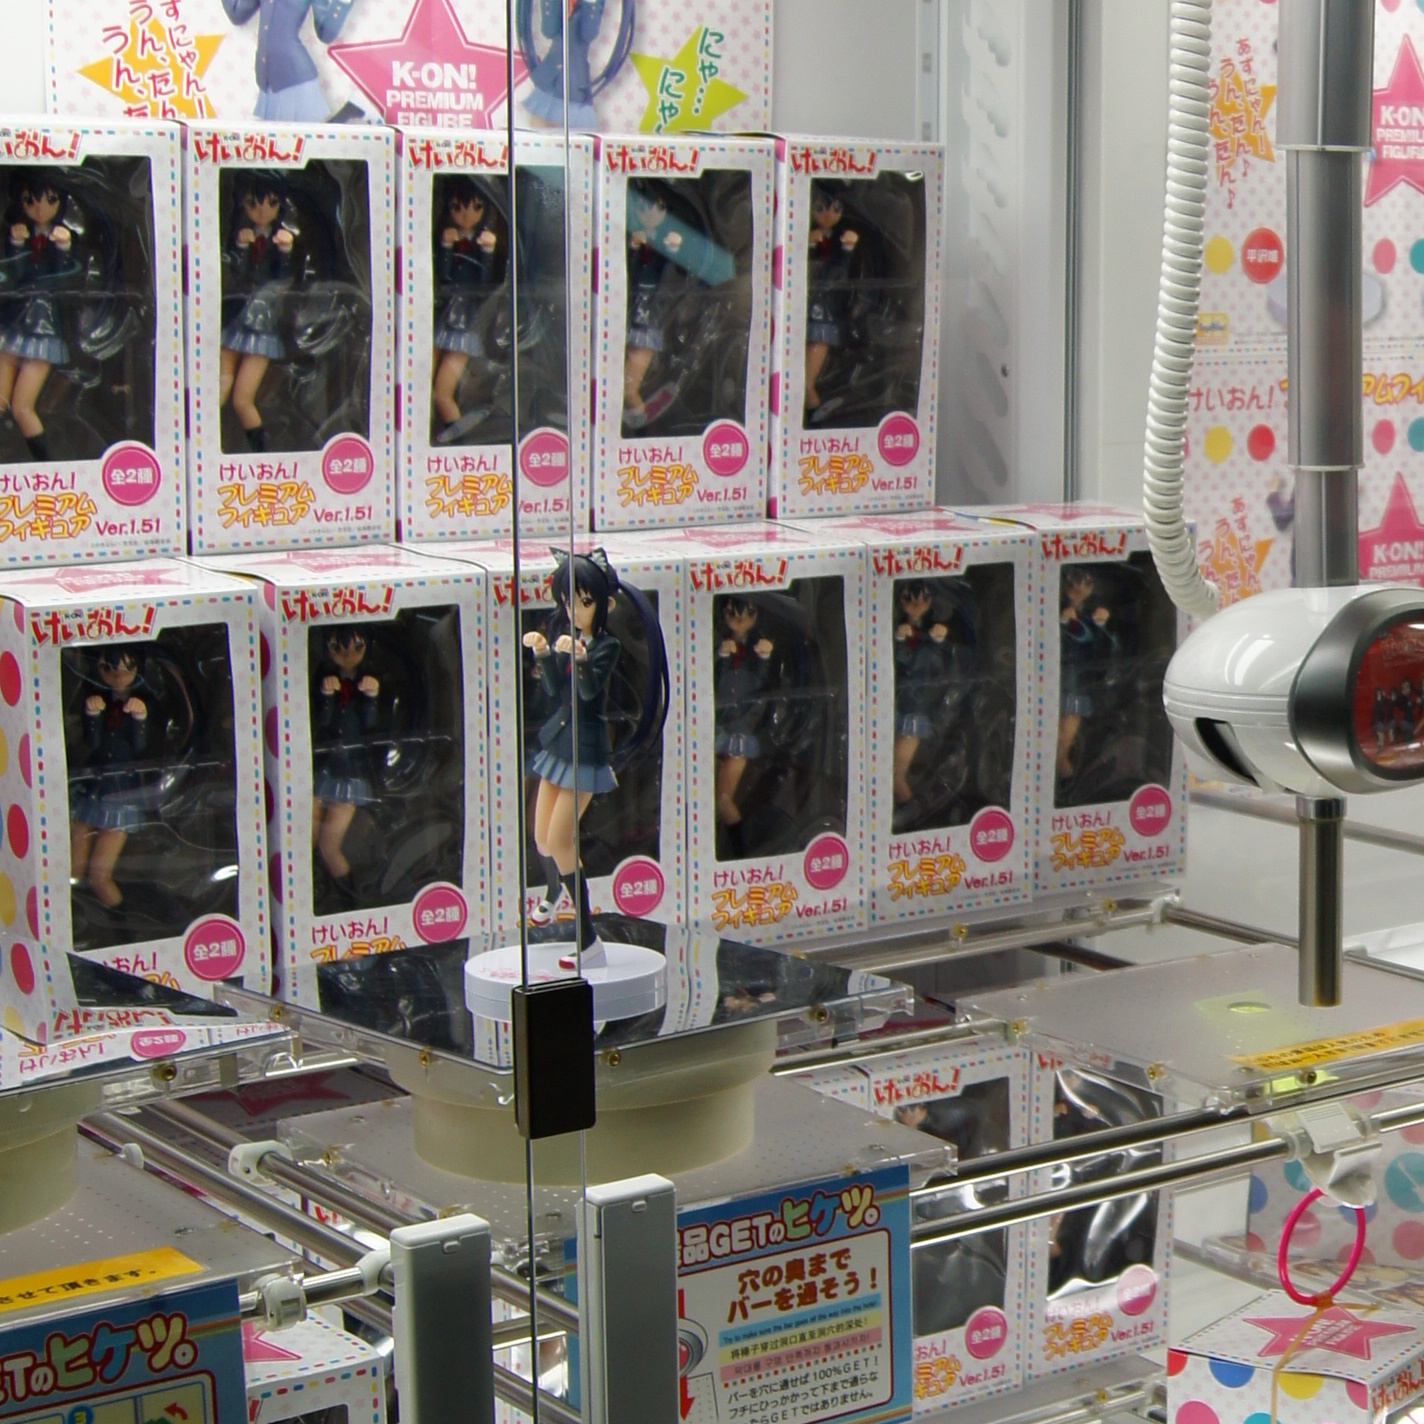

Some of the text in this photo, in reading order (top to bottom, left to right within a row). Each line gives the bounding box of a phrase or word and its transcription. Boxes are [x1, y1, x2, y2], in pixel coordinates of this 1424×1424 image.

[391, 60, 477, 90] K-ON!
[386, 89, 485, 112] PREMIUM
[194, 134, 306, 165] けいおん!
[606, 142, 699, 175] けいおん!
[790, 144, 877, 176] けいおん!
[618, 445, 684, 465] けいおん!
[800, 436, 860, 456] けいおん!
[219, 461, 299, 482] けいおん!
[426, 454, 498, 474] けいおん!
[617, 463, 699, 492] プレミアム
[798, 453, 874, 480] プレミアム
[217, 480, 316, 508] プレミアム
[425, 469, 514, 499] プレミアム
[617, 483, 695, 510] フィギュア
[697, 486, 748, 506] Ver.1.51
[798, 473, 868, 498] フィギュア
[871, 476, 918, 495] Ver.1.51
[217, 502, 312, 530] フィギュア
[313, 504, 373, 524] Ver.1.51
[425, 490, 511, 520] フィギュア
[96, 517, 161, 537] Ver.1.51
[1041, 532, 1128, 561] けいおん!
[1372, 539, 1424, 563] K-ON!
[872, 545, 964, 577] けいおん!
[690, 558, 788, 592] けいおん!
[281, 586, 396, 624] けいおん!
[31, 606, 157, 646] けいおん!
[1051, 811, 1112, 832] けいおん!
[887, 836, 951, 859] けいおん!
[1050, 828, 1125, 854] プレミアム
[1123, 844, 1171, 865] Ver.1.51
[886, 854, 966, 881] プレミアム
[1050, 845, 1121, 873] フィギュア
[714, 864, 784, 888] けいおん!
[886, 874, 961, 903] フィギュア
[965, 871, 1014, 892] Ver.1.51
[712, 882, 797, 910] プレミアム
[795, 897, 848, 920] Ver.1.51
[711, 901, 797, 932] フィギュア
[311, 917, 390, 946] けいおん!
[873, 1067, 962, 1106] けいおん!
[737, 1246, 852, 1295] 穴の奥まで
[1110, 1320, 1155, 1343] Ver.1.51
[0, 1311, 199, 1405] Tのヒケツ。
[959, 1362, 1006, 1388] Ver.1.51
